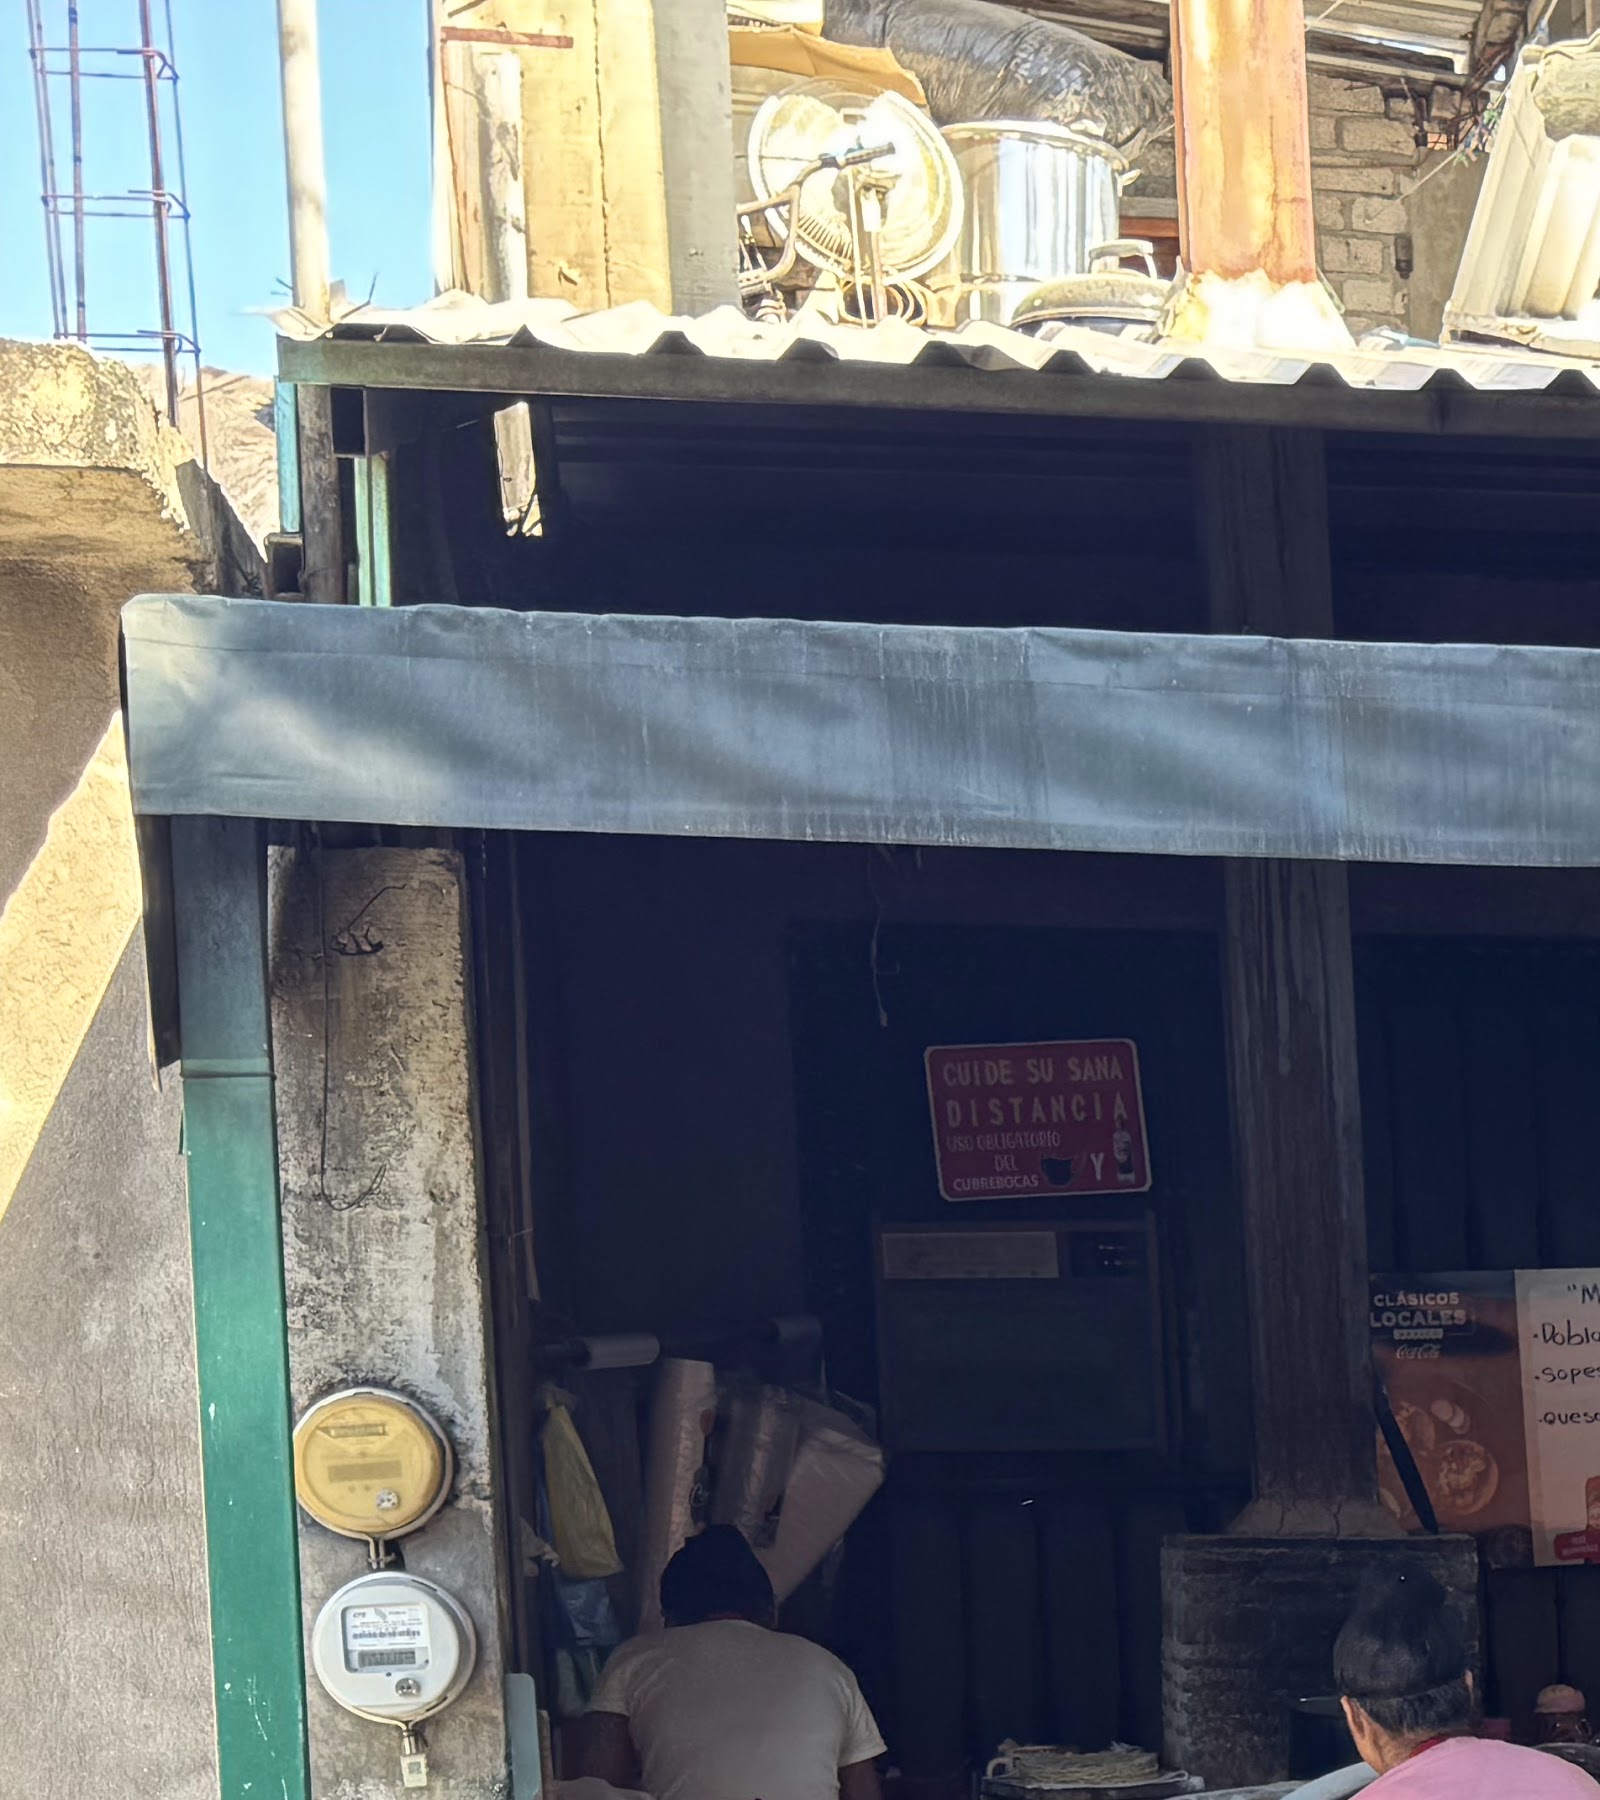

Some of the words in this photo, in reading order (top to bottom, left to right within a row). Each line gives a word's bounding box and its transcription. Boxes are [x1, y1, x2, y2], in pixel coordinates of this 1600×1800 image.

[943, 1058, 1016, 1087] CUIDE
[1025, 1057, 1054, 1084] SU
[1066, 1054, 1125, 1083] SANA
[946, 1090, 1128, 1129] DISTANCIA
[992, 1152, 1019, 1172] DEL
[1089, 1152, 1105, 1182] Y
[953, 1173, 1040, 1192] CUBREBOCAS
[1373, 1290, 1460, 1307] CLÁSICOS
[1370, 1308, 1467, 1328] LOCALES
